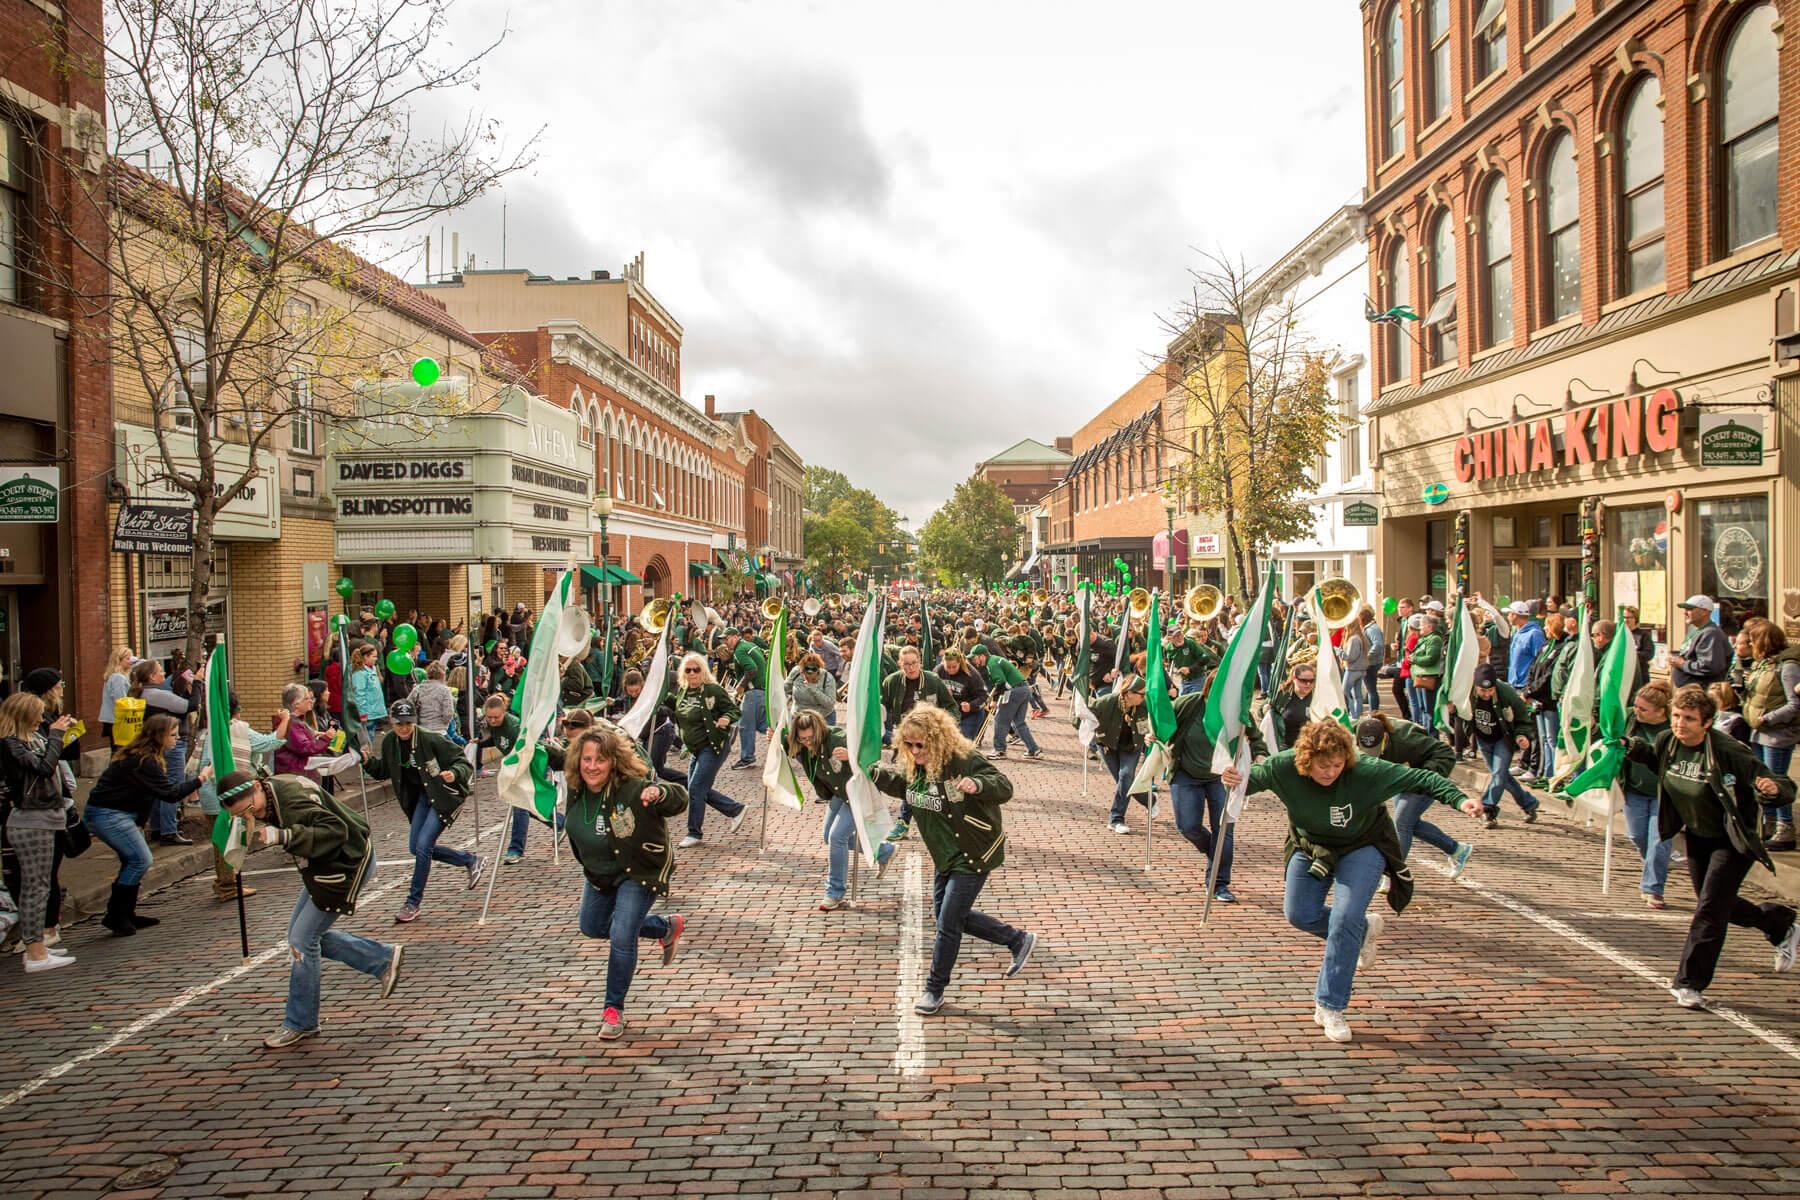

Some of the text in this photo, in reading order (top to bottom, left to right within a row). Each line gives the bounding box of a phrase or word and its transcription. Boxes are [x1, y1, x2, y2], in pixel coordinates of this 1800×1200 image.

[528, 422, 576, 465] ATHENA
[1454, 388, 1681, 483] CHINA KING
[1703, 430, 1761, 446] COURT STREET
[339, 461, 464, 480] DAVEED DIGGS
[27, 484, 55, 500] STREET
[342, 498, 472, 515] BLINDSPOTTING
[119, 513, 188, 533] Chop Shop
[140, 510, 157, 520] The
[125, 530, 186, 538] BARBERSHOP
[114, 540, 190, 553] Walk Ins Welcome
